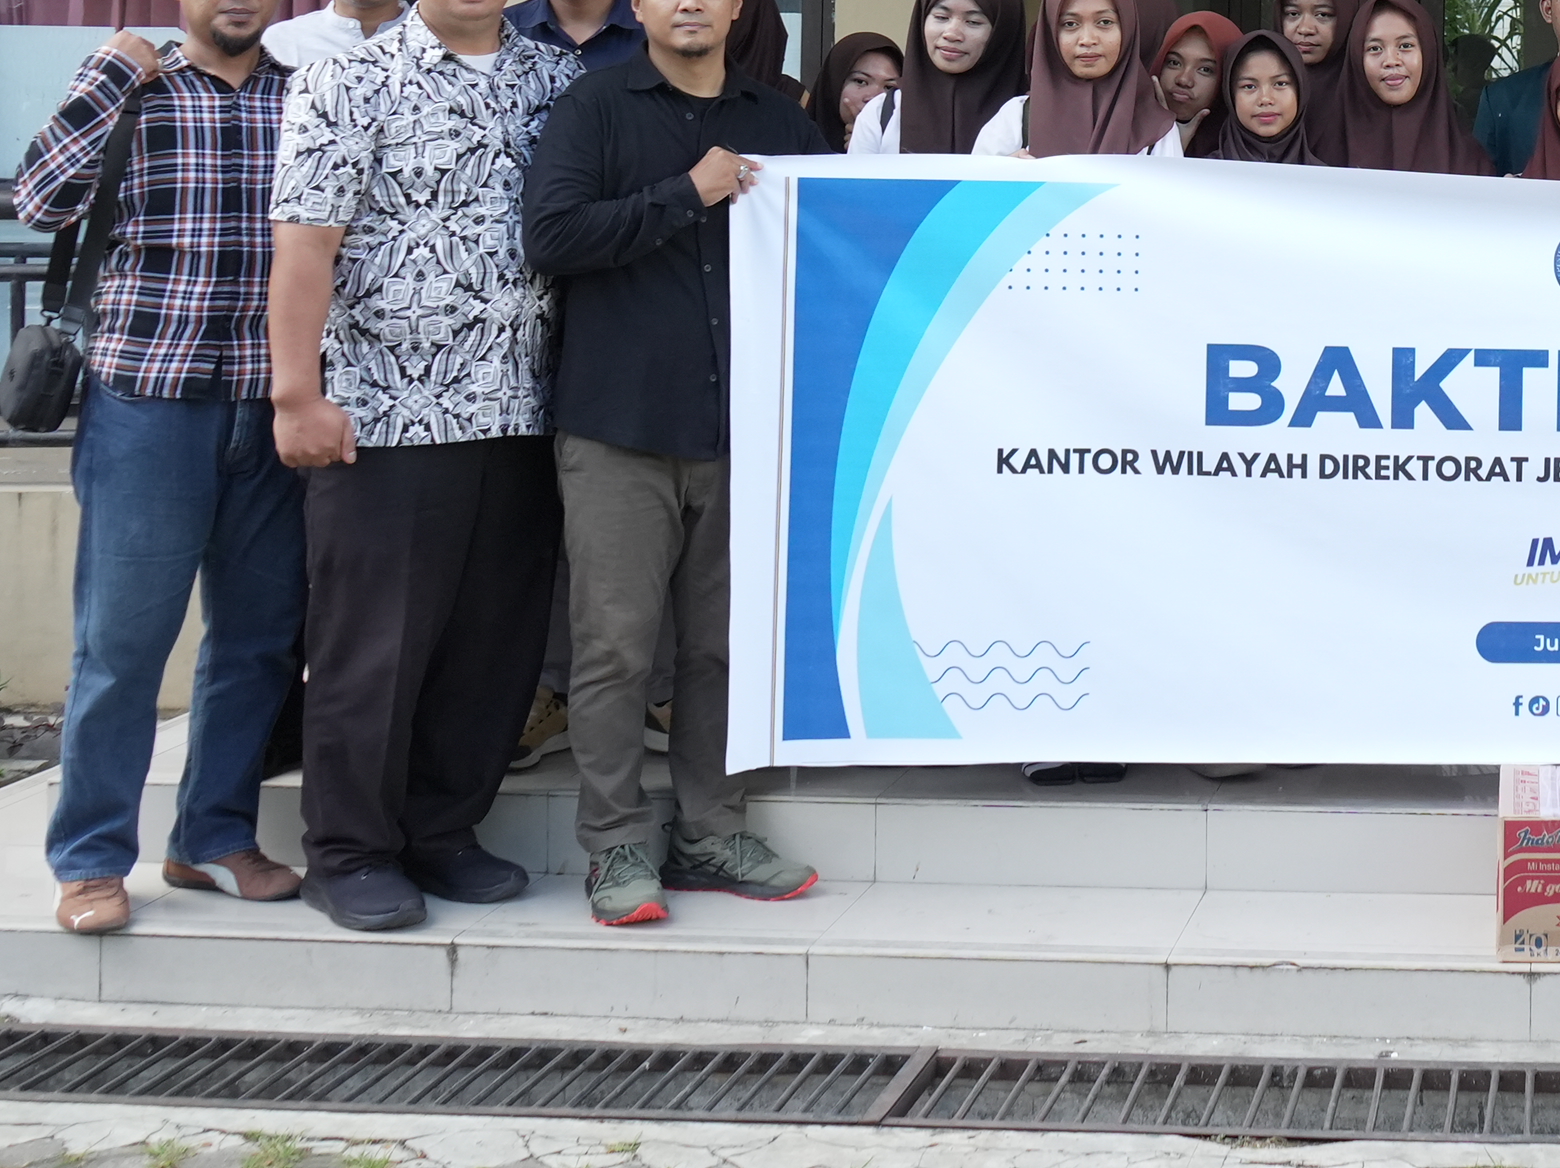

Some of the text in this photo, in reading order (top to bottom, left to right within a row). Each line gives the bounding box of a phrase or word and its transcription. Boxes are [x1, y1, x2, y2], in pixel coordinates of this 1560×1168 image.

[997, 448, 1141, 475] KANTOR
[1150, 449, 1308, 480] WILAYAH
[1319, 454, 1529, 483] DIREKTORAT
[1527, 862, 1538, 871] Mi
[1517, 879, 1544, 893] Mi
